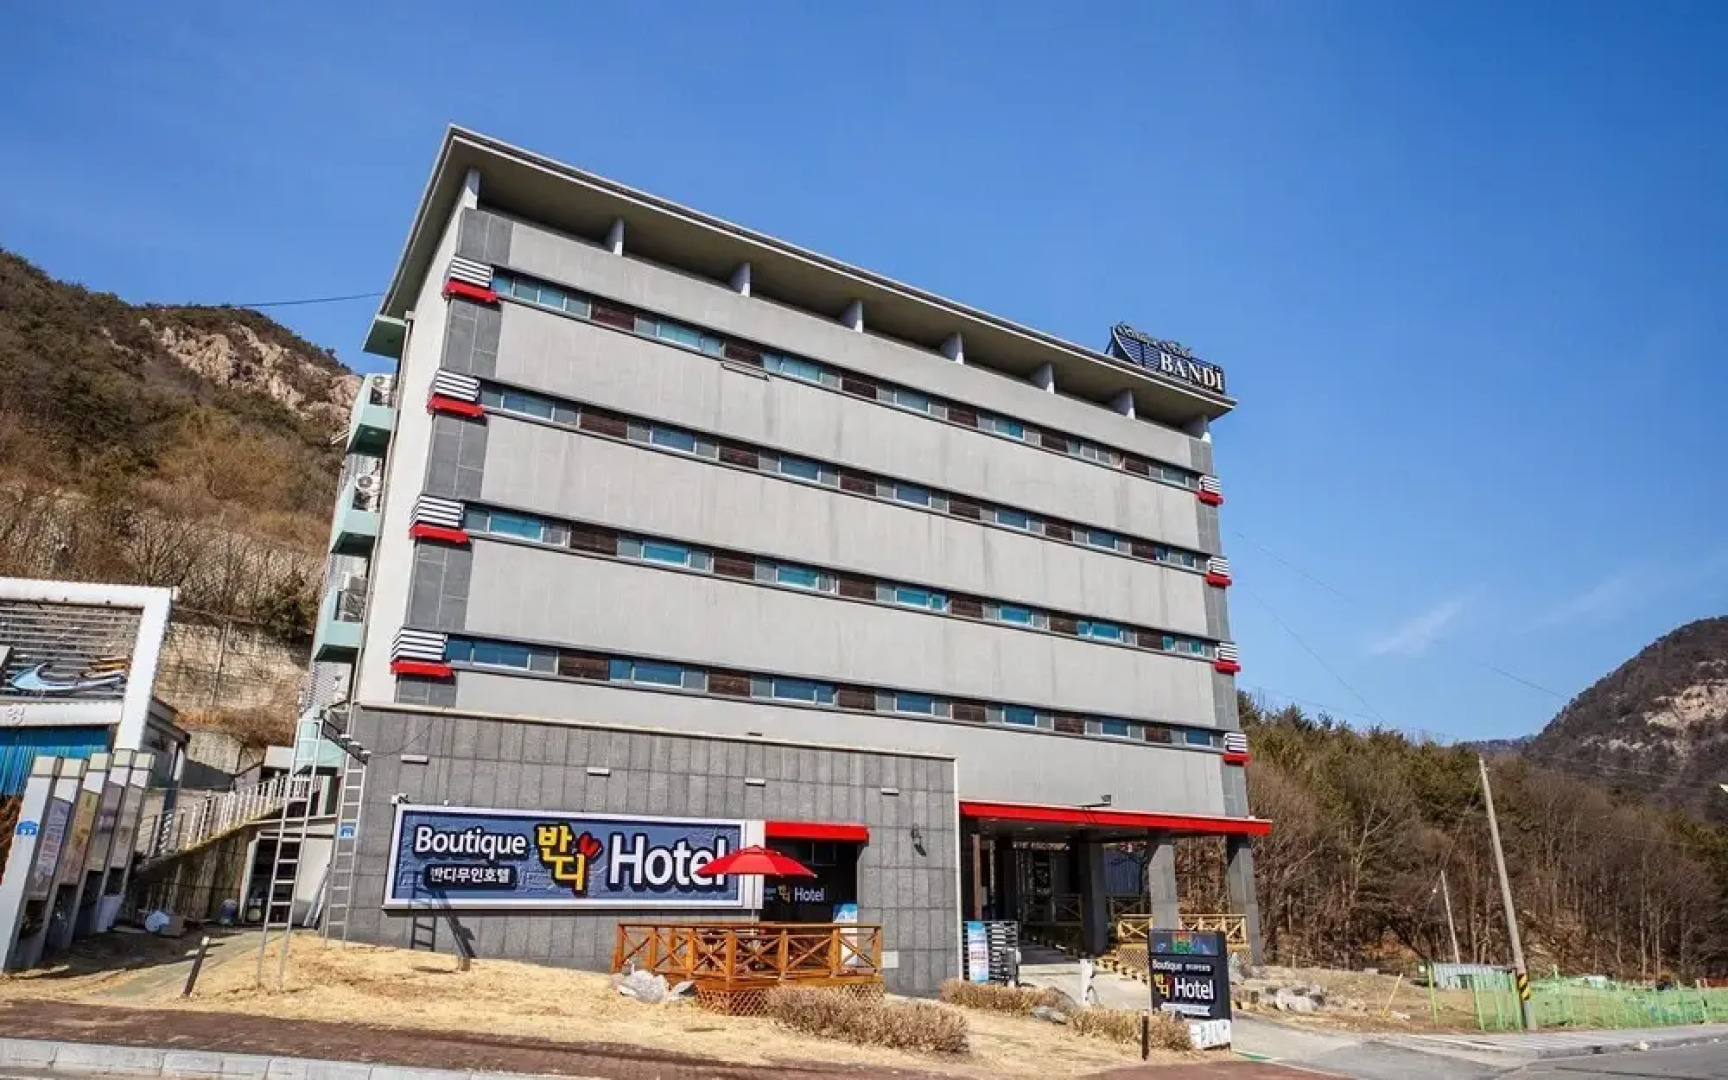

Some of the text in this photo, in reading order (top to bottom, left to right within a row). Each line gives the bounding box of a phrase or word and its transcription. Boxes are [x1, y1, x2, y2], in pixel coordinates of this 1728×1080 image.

[415, 825, 726, 891] Boutique 반디 Hotel
[430, 866, 511, 884] 반디무인호텔
[794, 887, 825, 903] Hotel
[1174, 977, 1214, 1000] Hotel
